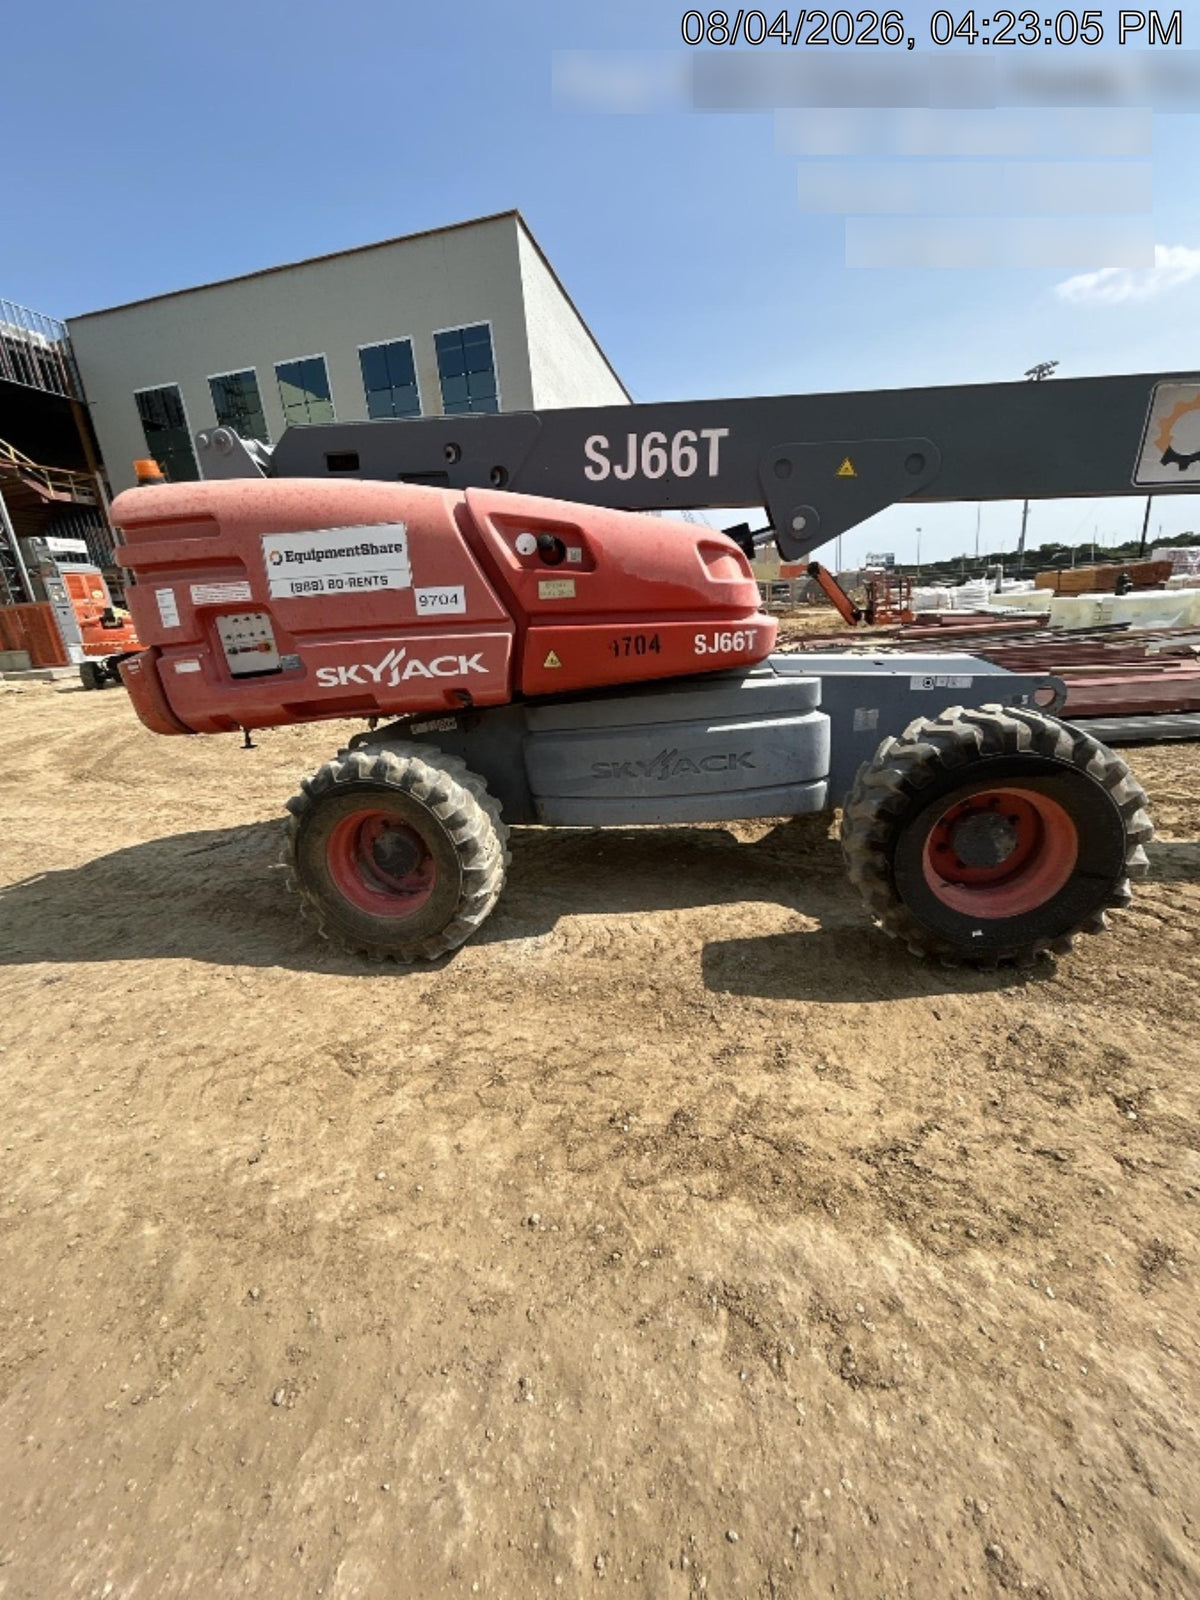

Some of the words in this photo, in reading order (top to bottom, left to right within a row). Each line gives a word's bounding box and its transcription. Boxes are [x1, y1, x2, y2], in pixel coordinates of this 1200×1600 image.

[584, 428, 729, 481] SJ66T
[284, 543, 403, 564] EquipmentShare
[290, 580, 325, 594] (888)
[328, 575, 389, 590] 80-RENTS
[418, 593, 459, 608] 9704
[694, 629, 757, 655] SJ66T
[315, 647, 489, 687] SKYJACK
[591, 748, 756, 781] SKYJACK
